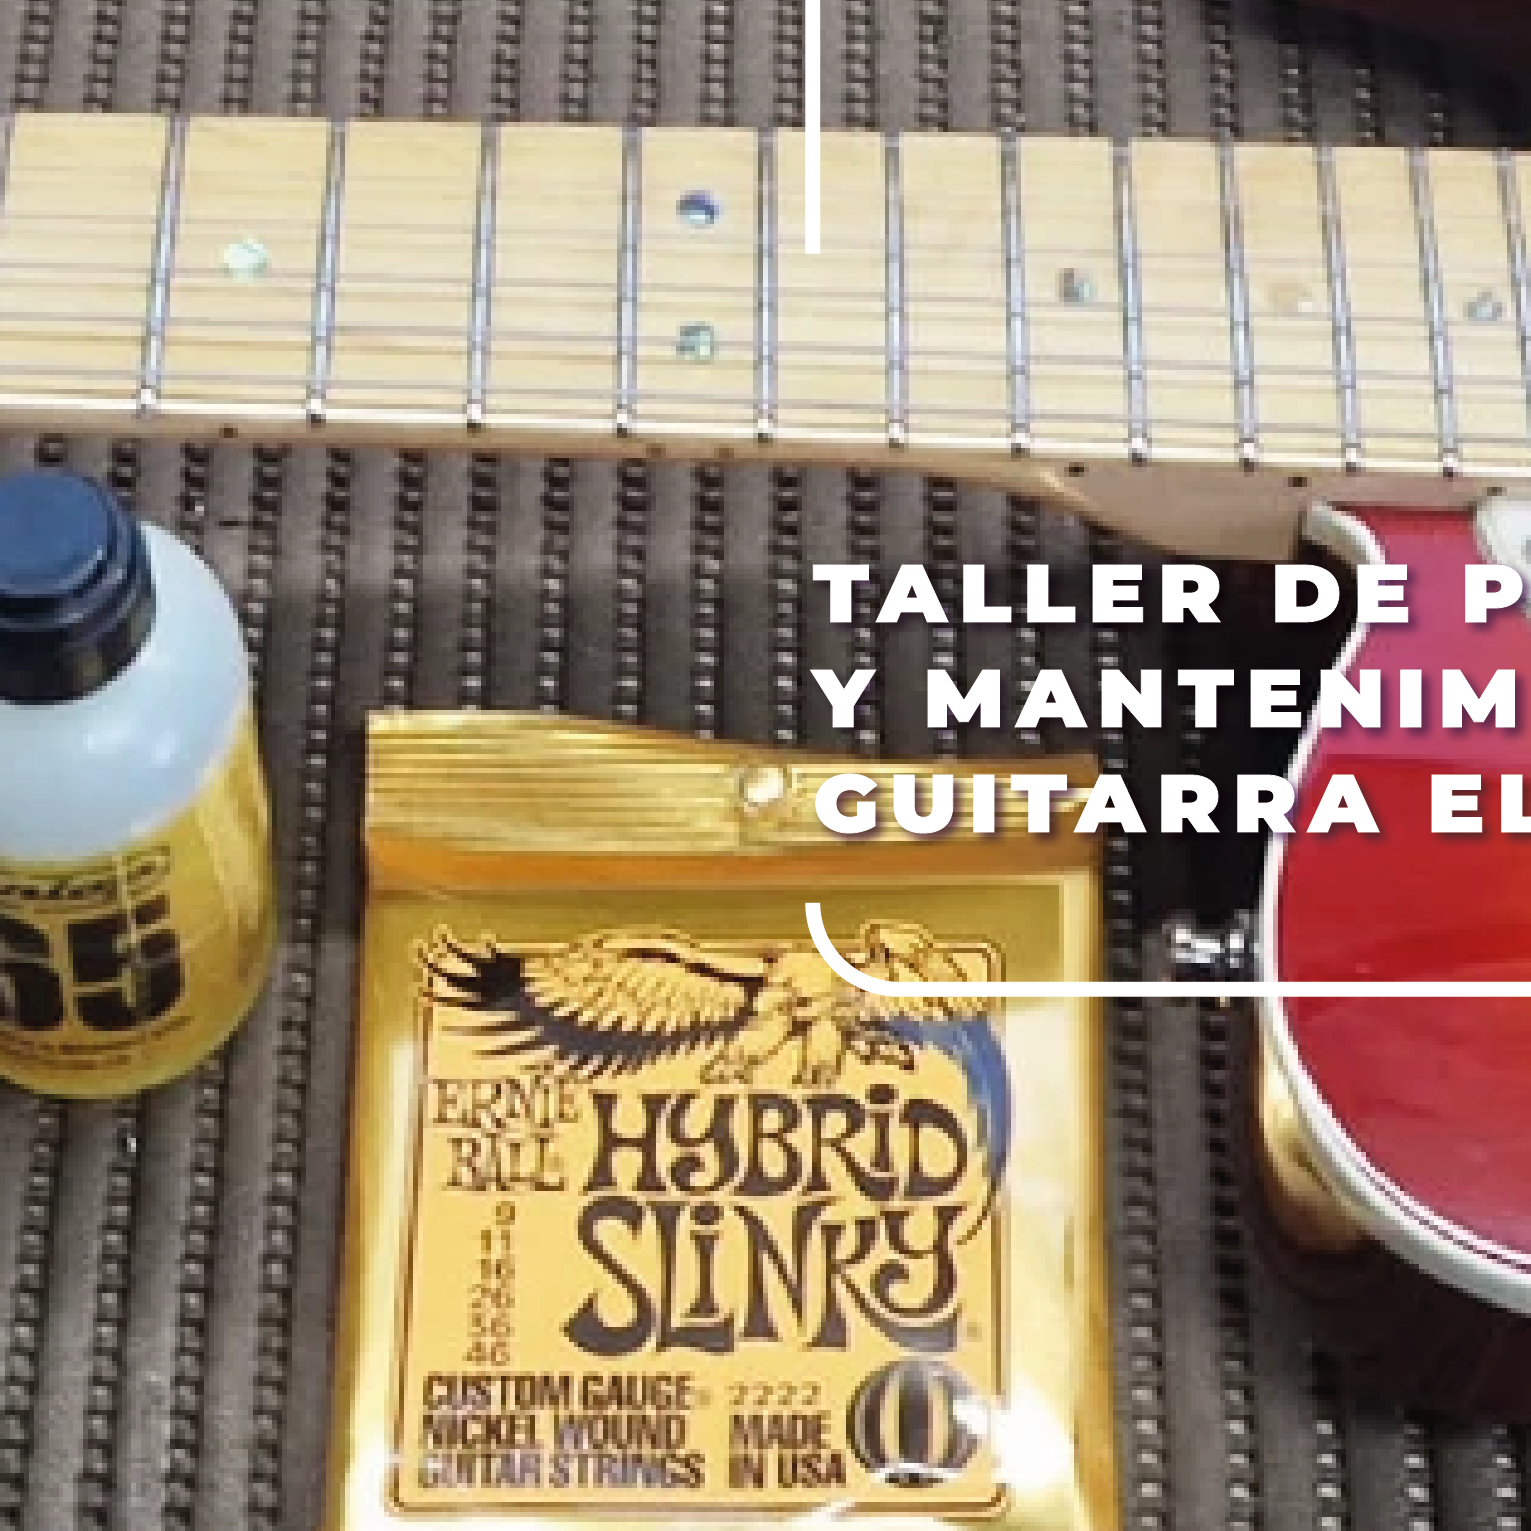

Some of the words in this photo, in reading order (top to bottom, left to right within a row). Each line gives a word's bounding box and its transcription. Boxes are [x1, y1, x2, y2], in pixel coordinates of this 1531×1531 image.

[431, 1074, 580, 1131] ERNIE
[446, 1134, 566, 1193] BALL
[422, 1374, 571, 1410] CUSTOM
[581, 1374, 692, 1411] GAUGE
[421, 1414, 540, 1449] NICKEL
[556, 1413, 686, 1450] WOUND
[729, 1413, 832, 1448] MADE
[418, 1453, 540, 1490] GUITAR
[550, 1453, 706, 1490] STRINGS
[729, 1453, 765, 1488] IN
[778, 1452, 846, 1488] USA
